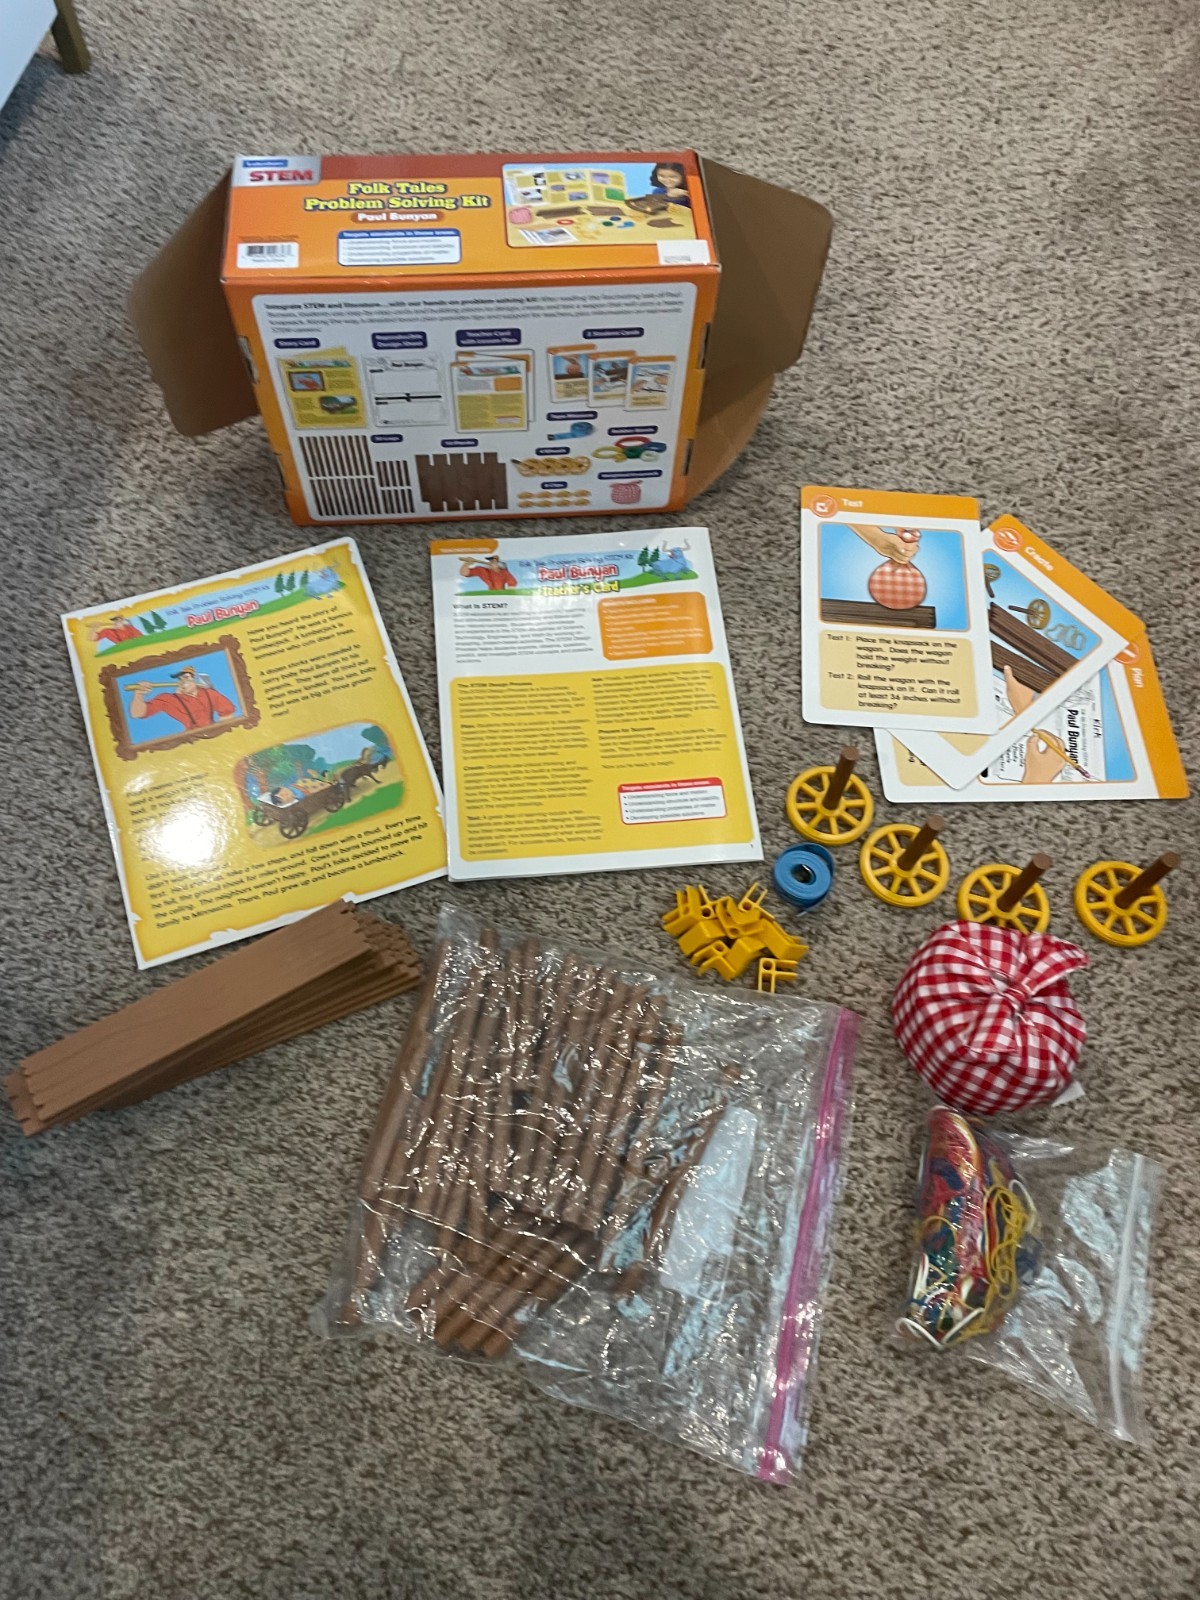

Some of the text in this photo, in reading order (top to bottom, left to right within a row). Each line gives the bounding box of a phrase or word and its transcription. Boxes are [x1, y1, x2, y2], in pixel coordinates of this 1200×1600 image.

[250, 170, 313, 182] STEM
[348, 182, 446, 194] Folk Tales
[305, 195, 490, 210] Problem Solving Kit
[357, 212, 438, 222] Paul Bunyan
[841, 498, 862, 507] Test
[1024, 546, 1054, 572] Create
[538, 563, 619, 582] Paul Bunyan
[542, 580, 620, 596] Teacher's Card
[187, 601, 259, 627] Paul Bunyan
[893, 639, 929, 647] knapsack
[856, 662, 894, 671] breaking?
[1130, 667, 1144, 688] Plan
[858, 682, 893, 691] knapsack
[858, 700, 897, 710] breaking?
[1064, 708, 1080, 764] Paul Bunyan
